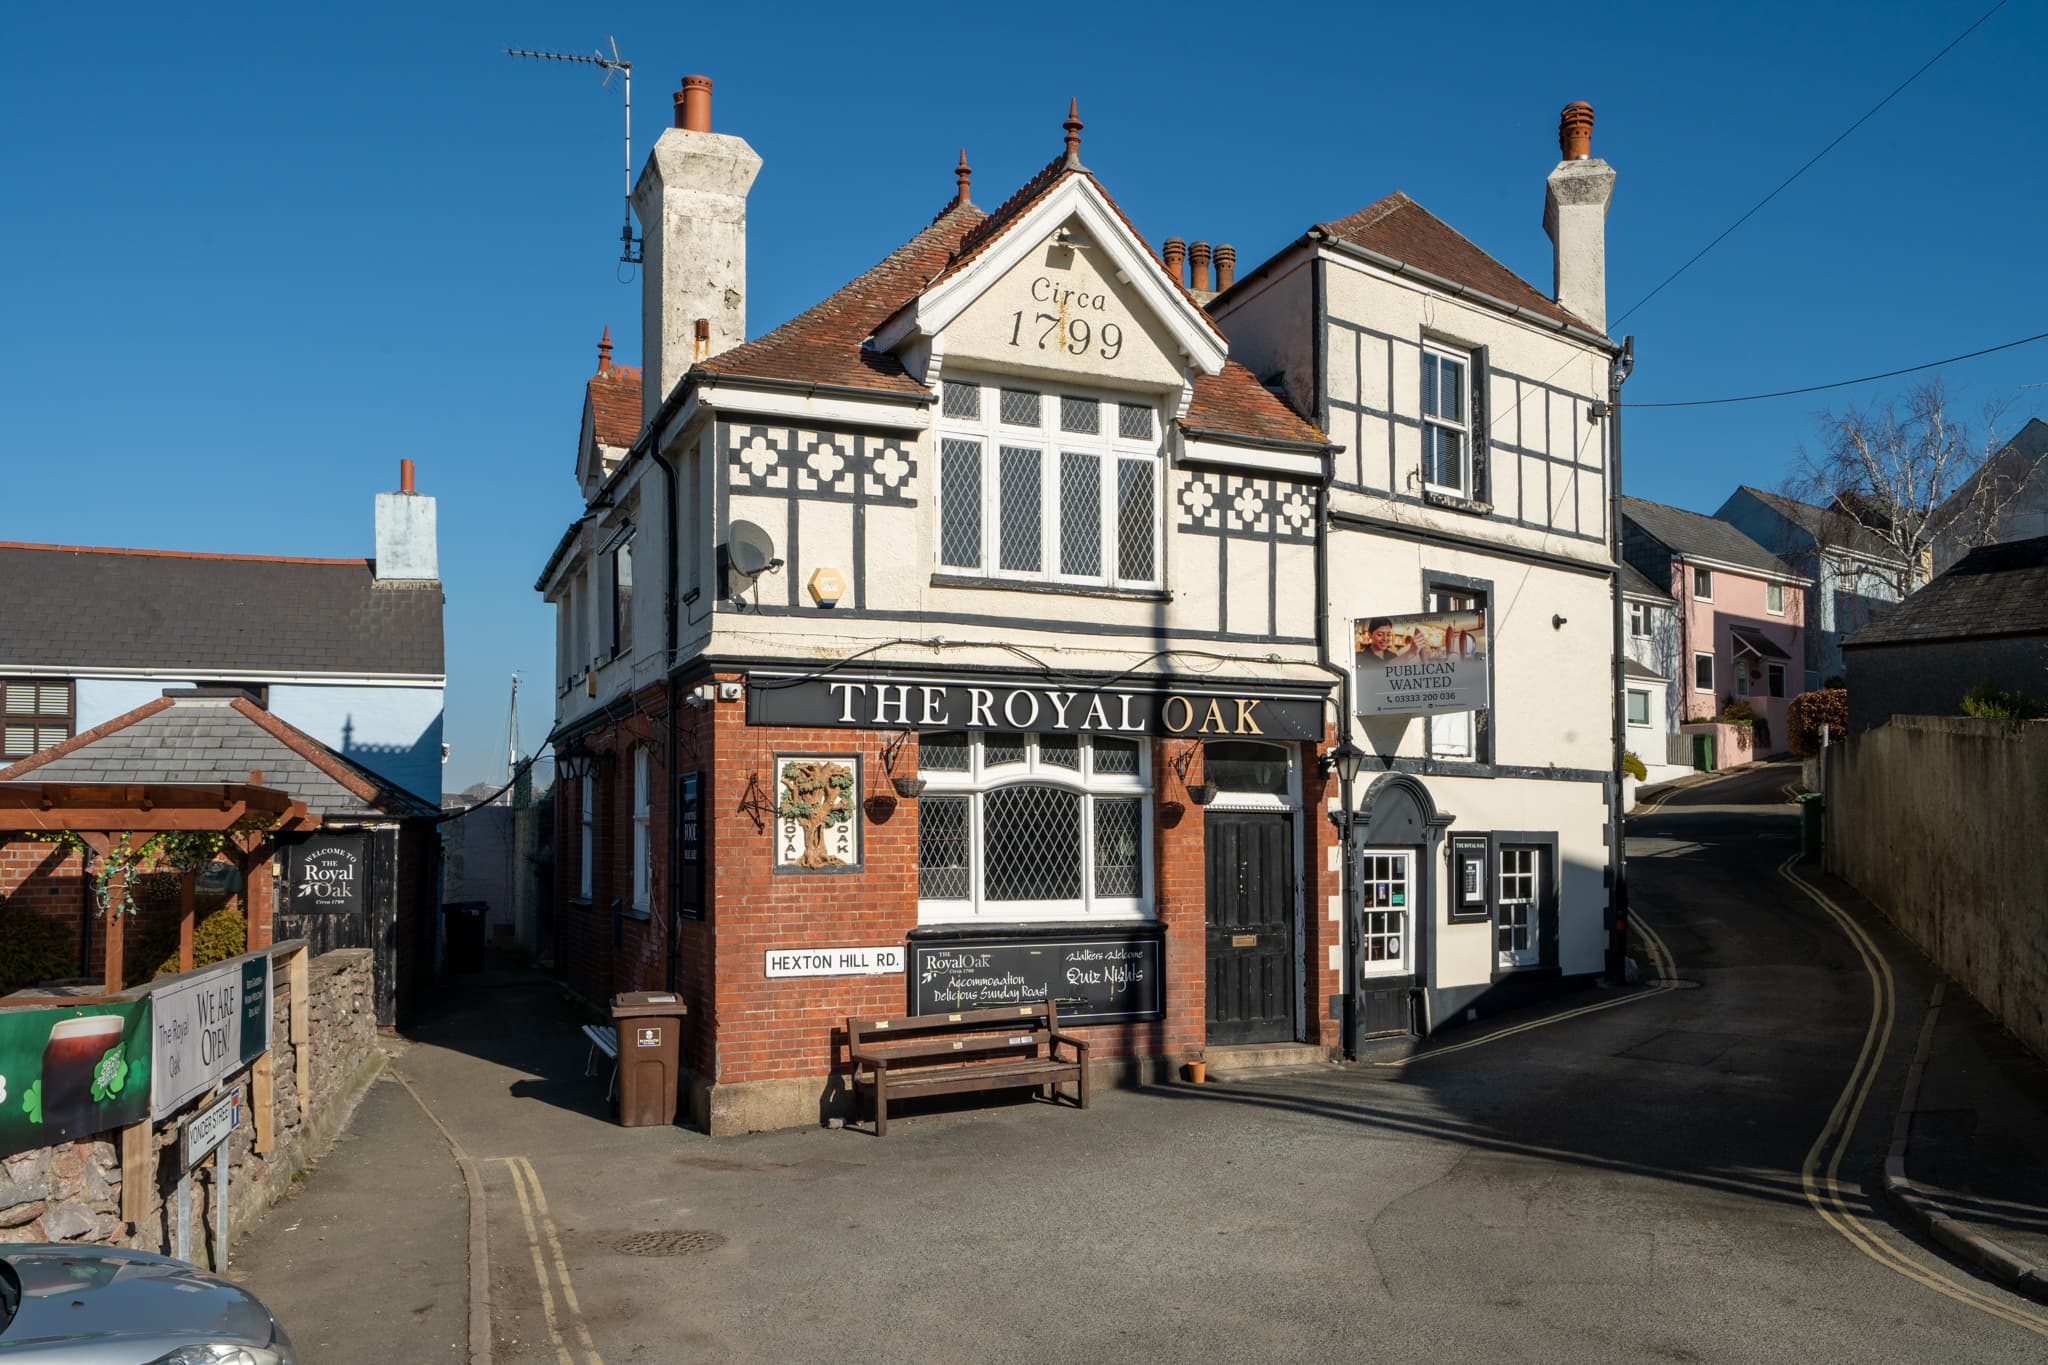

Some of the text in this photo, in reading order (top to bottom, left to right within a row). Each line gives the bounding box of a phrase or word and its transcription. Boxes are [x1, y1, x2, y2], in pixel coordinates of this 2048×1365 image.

[1031, 276, 1106, 312] Circa
[1008, 310, 1123, 360] 1799
[1385, 662, 1455, 678] PUBLICAN
[1389, 676, 1452, 690] WANTED
[829, 682, 1264, 735] THE ROYAL OAK
[1394, 692, 1456, 703] 03333 200 036
[784, 817, 797, 862] ROYAL
[836, 825, 849, 854] OAK
[304, 847, 357, 863] WELCOME TO
[303, 864, 353, 882] Royal
[313, 881, 353, 898] Oak
[771, 952, 900, 971] HEXTON HILL RD.
[1066, 962, 1144, 993] Quiz Nights
[933, 982, 1048, 1004] Delicious Sunday Roast
[197, 984, 234, 1029] WE ARE
[159, 1023, 172, 1048] The
[189, 1099, 231, 1147] YONDER STREET
